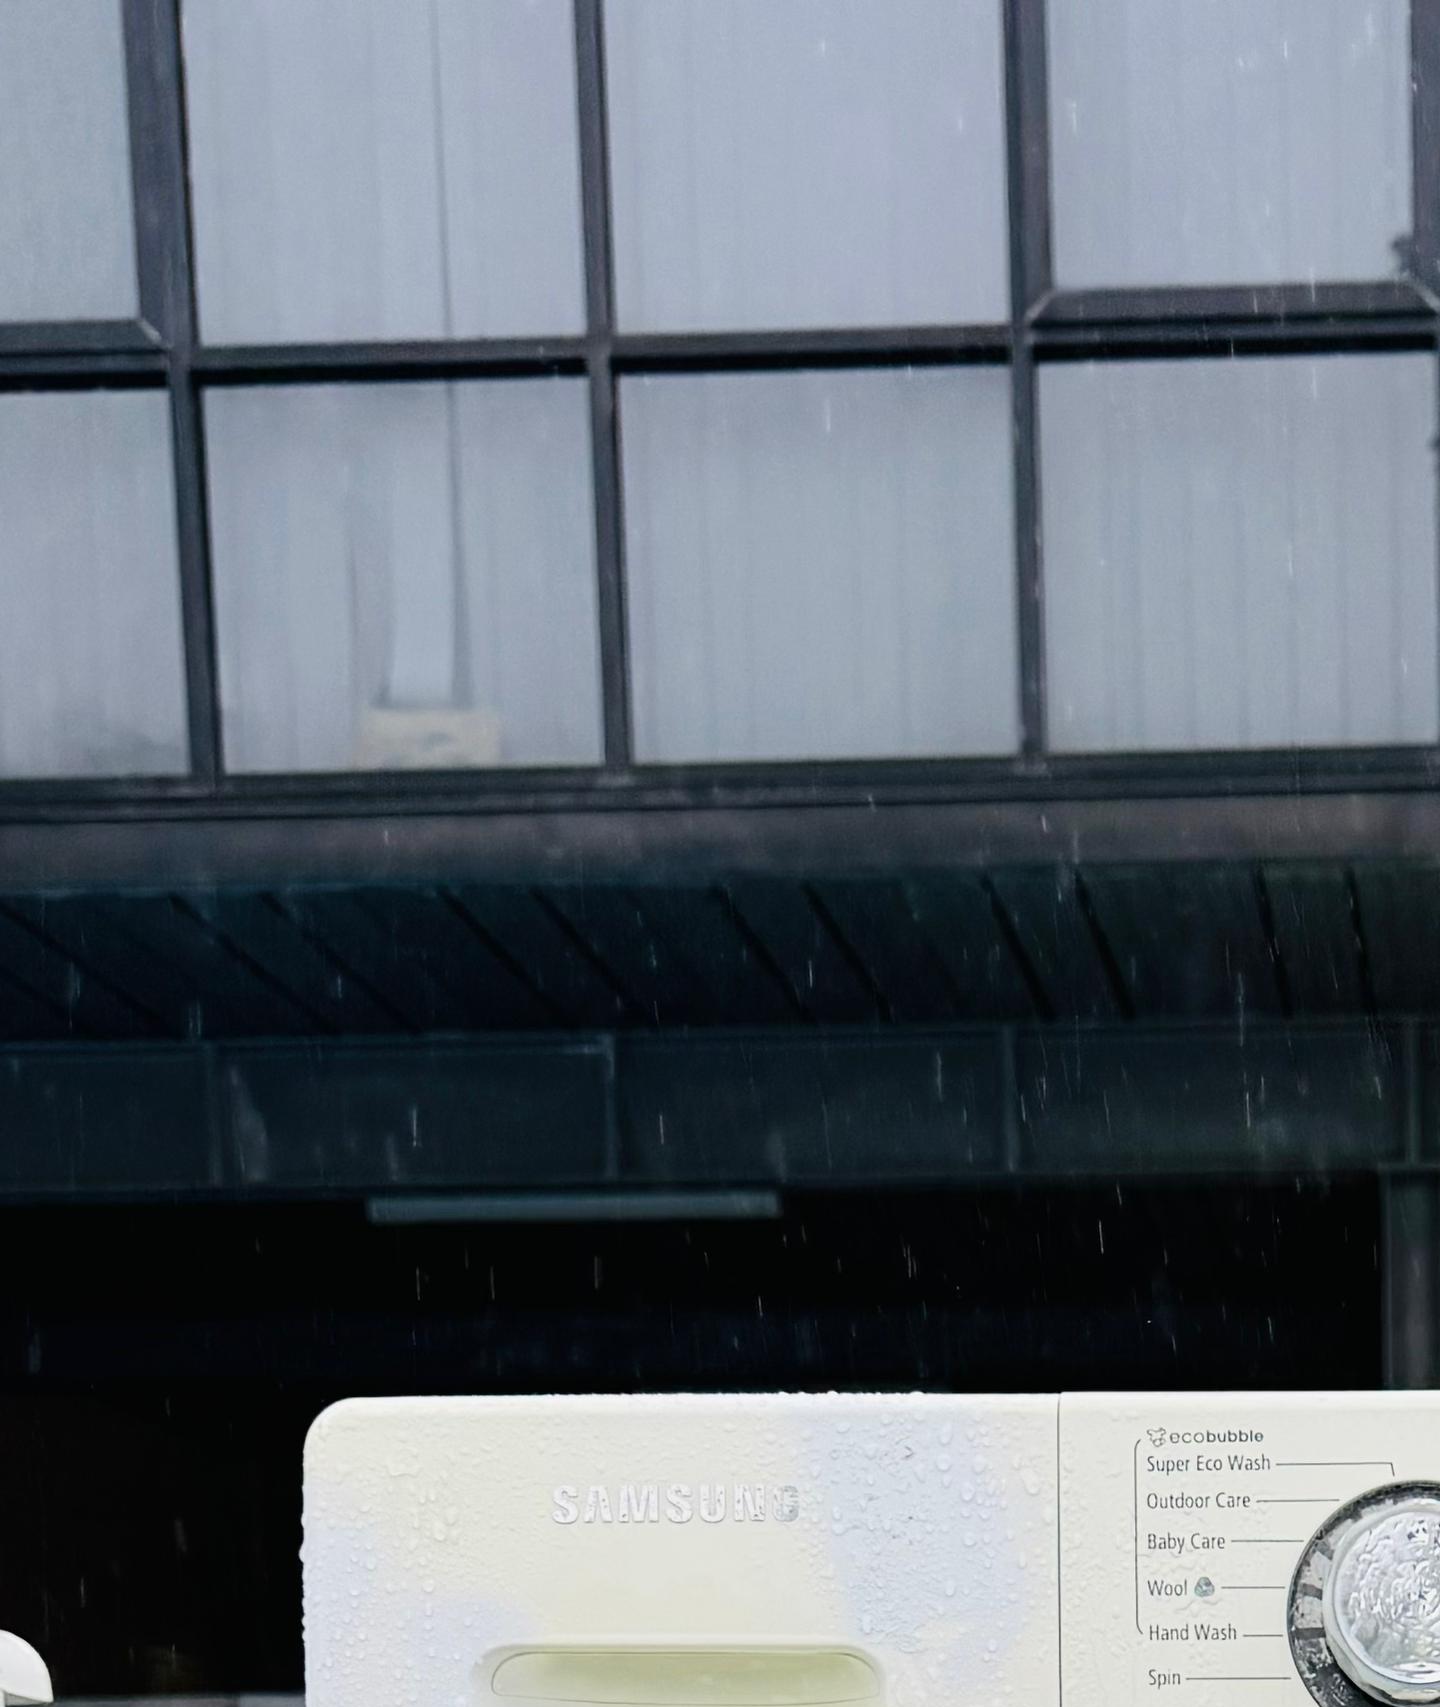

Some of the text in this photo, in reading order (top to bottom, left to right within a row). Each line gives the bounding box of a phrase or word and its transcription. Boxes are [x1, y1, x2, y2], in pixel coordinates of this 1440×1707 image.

[1169, 1430, 1264, 1444] ecobubble
[1147, 1453, 1271, 1476] Super Eco Wash
[551, 1484, 800, 1525] SAMSUNG
[1147, 1491, 1251, 1509] Outdoor Care
[1147, 1532, 1226, 1554] Baby Care
[1148, 1579, 1188, 1596] Wool
[1149, 1623, 1237, 1640] Hand Wash
[1148, 1668, 1181, 1690] Spin
